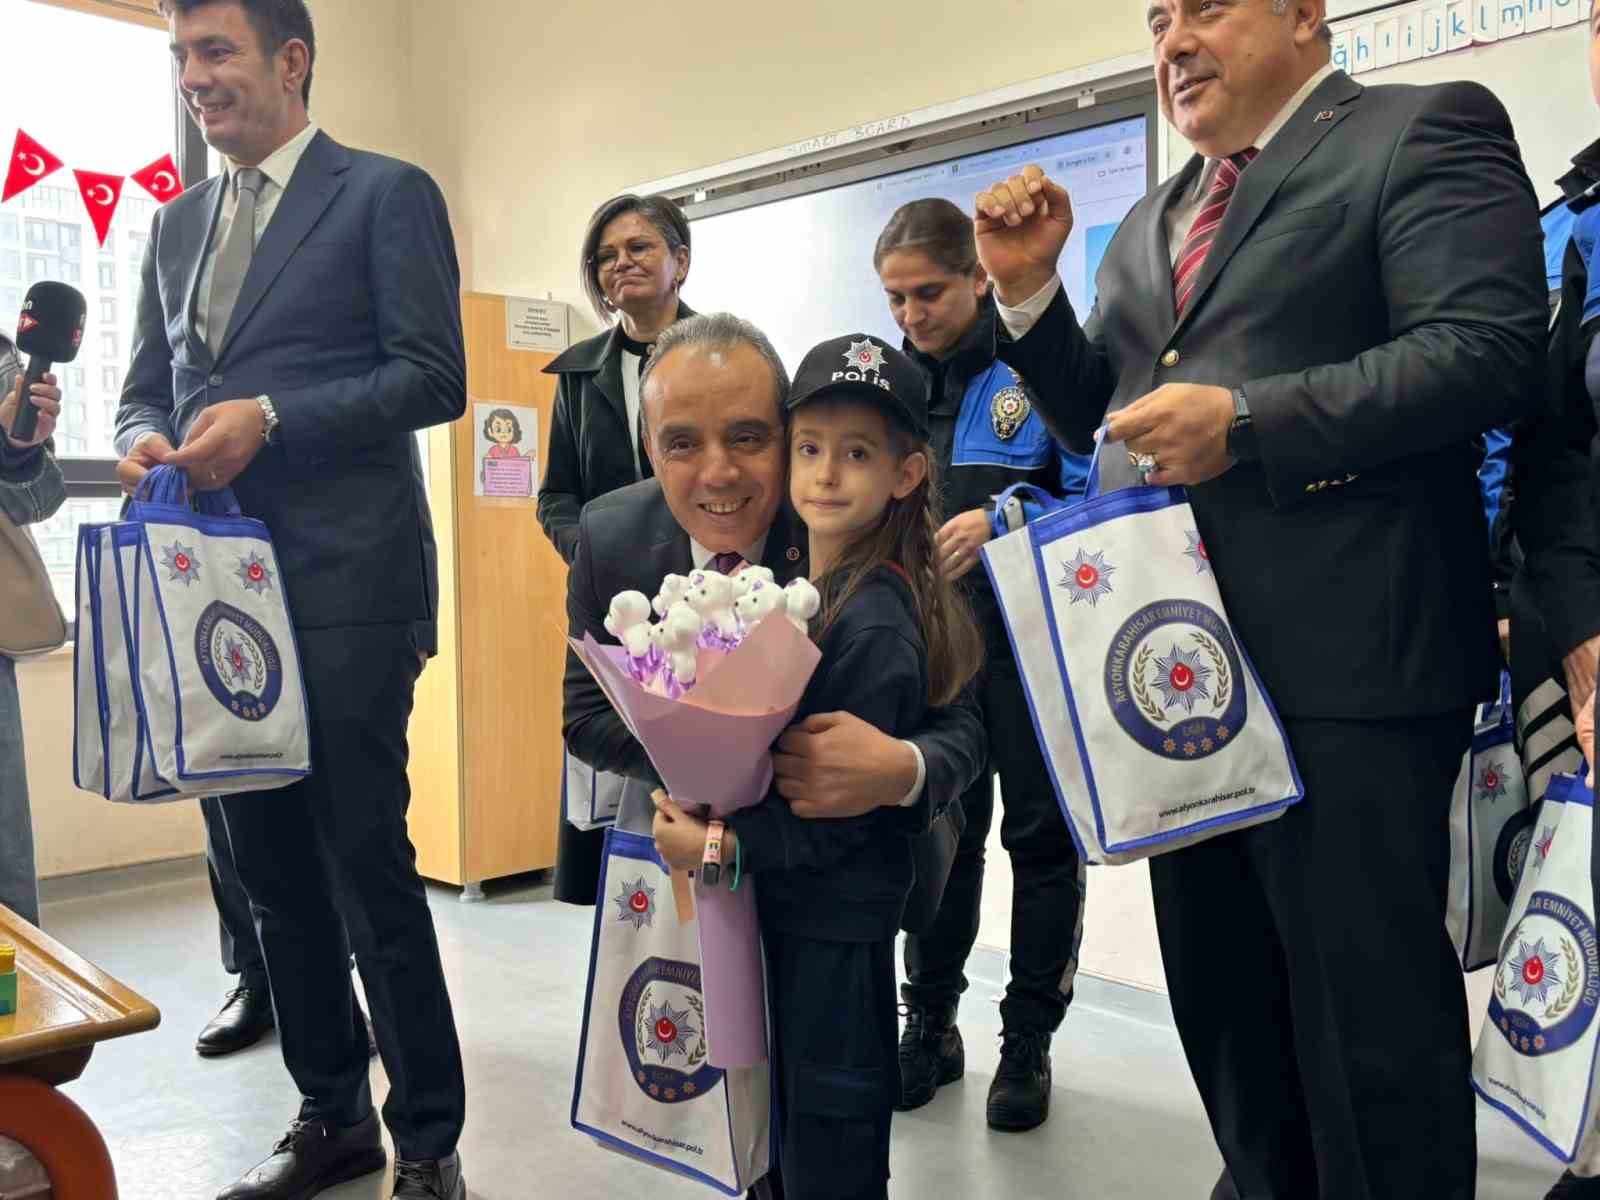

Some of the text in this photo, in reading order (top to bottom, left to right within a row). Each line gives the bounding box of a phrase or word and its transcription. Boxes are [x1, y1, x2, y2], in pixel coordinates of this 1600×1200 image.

[1356, 36, 1369, 61] h
[1427, 18, 1440, 53] j
[1452, 11, 1466, 37] k
[1502, 4, 1524, 24] m
